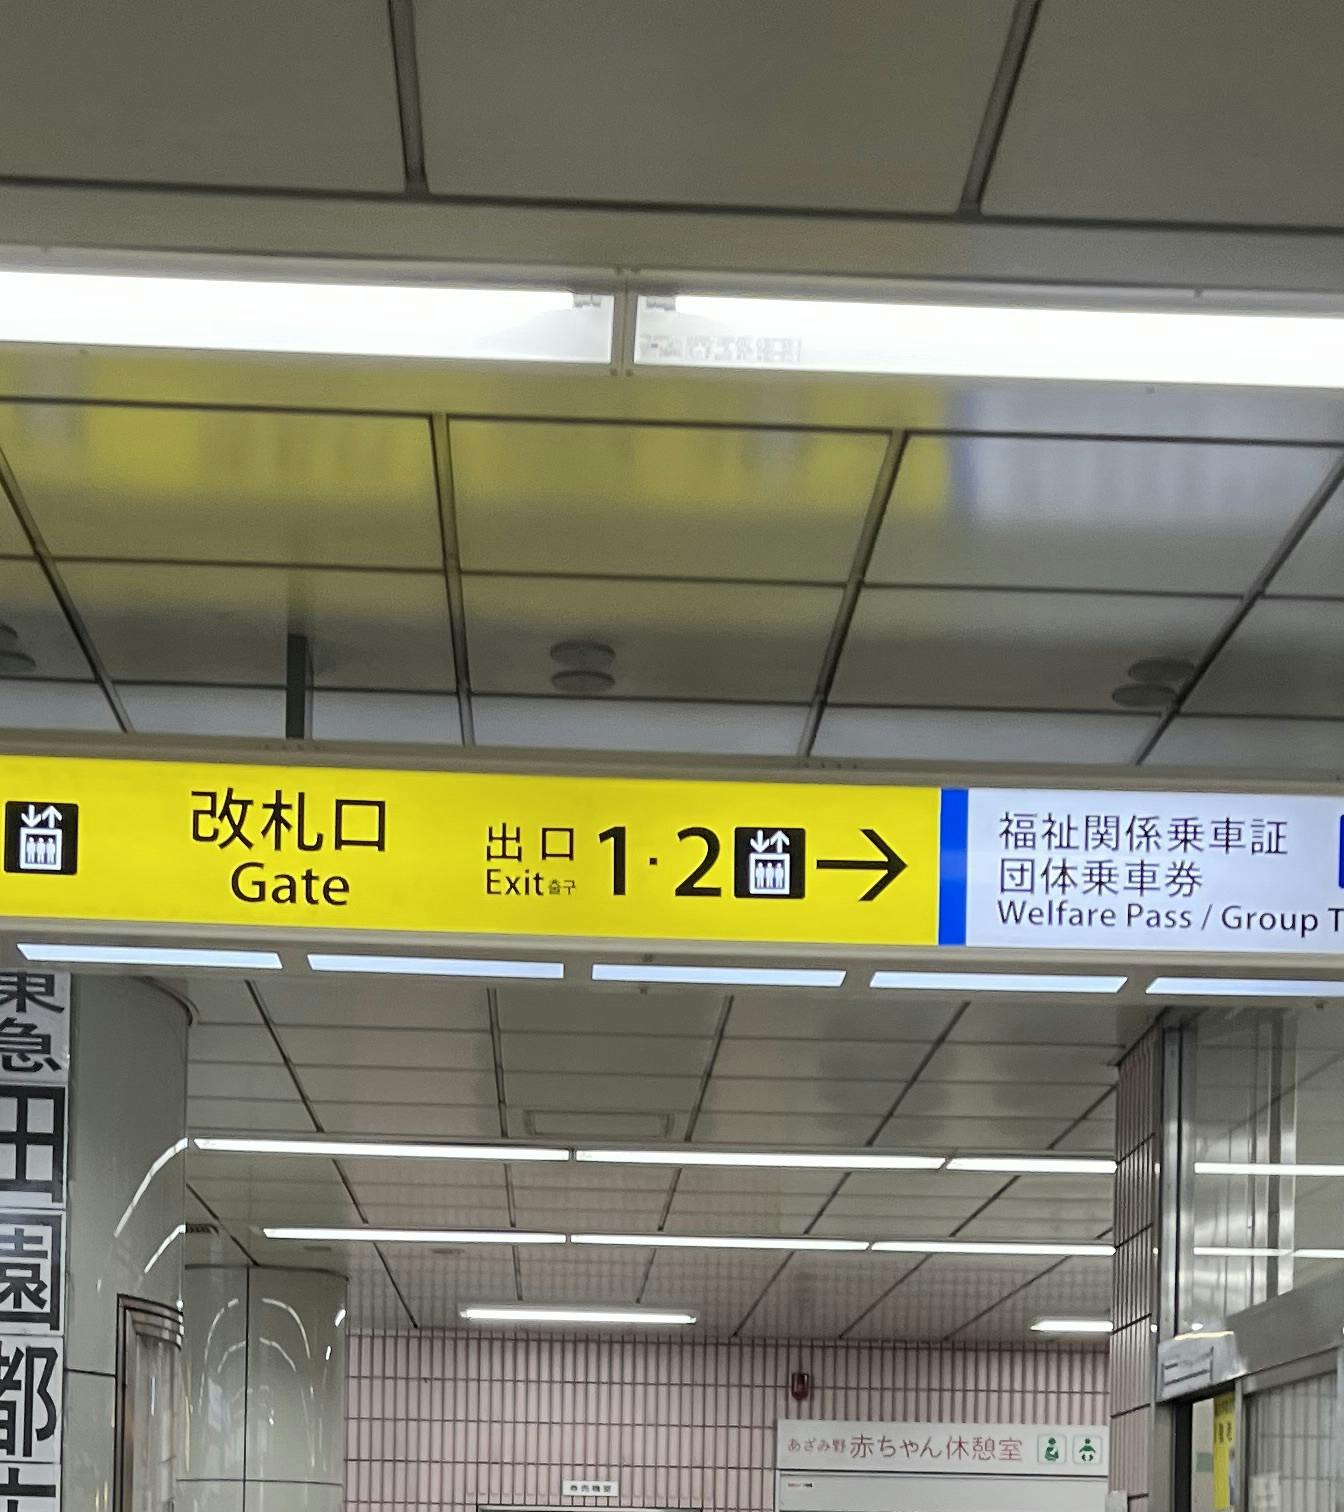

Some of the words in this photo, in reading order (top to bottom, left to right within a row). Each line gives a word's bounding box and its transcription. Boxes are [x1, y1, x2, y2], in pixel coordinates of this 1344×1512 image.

[191, 786, 387, 853] 改札口
[998, 811, 1288, 856] 福祉関係乗車証
[486, 822, 575, 863] 出口
[231, 862, 350, 906] Gate
[486, 868, 545, 897] Exit
[999, 857, 1203, 897] 団体乗車券
[998, 900, 1116, 928] Welfare
[1127, 903, 1192, 929] Pass
[1221, 904, 1318, 938] Group
